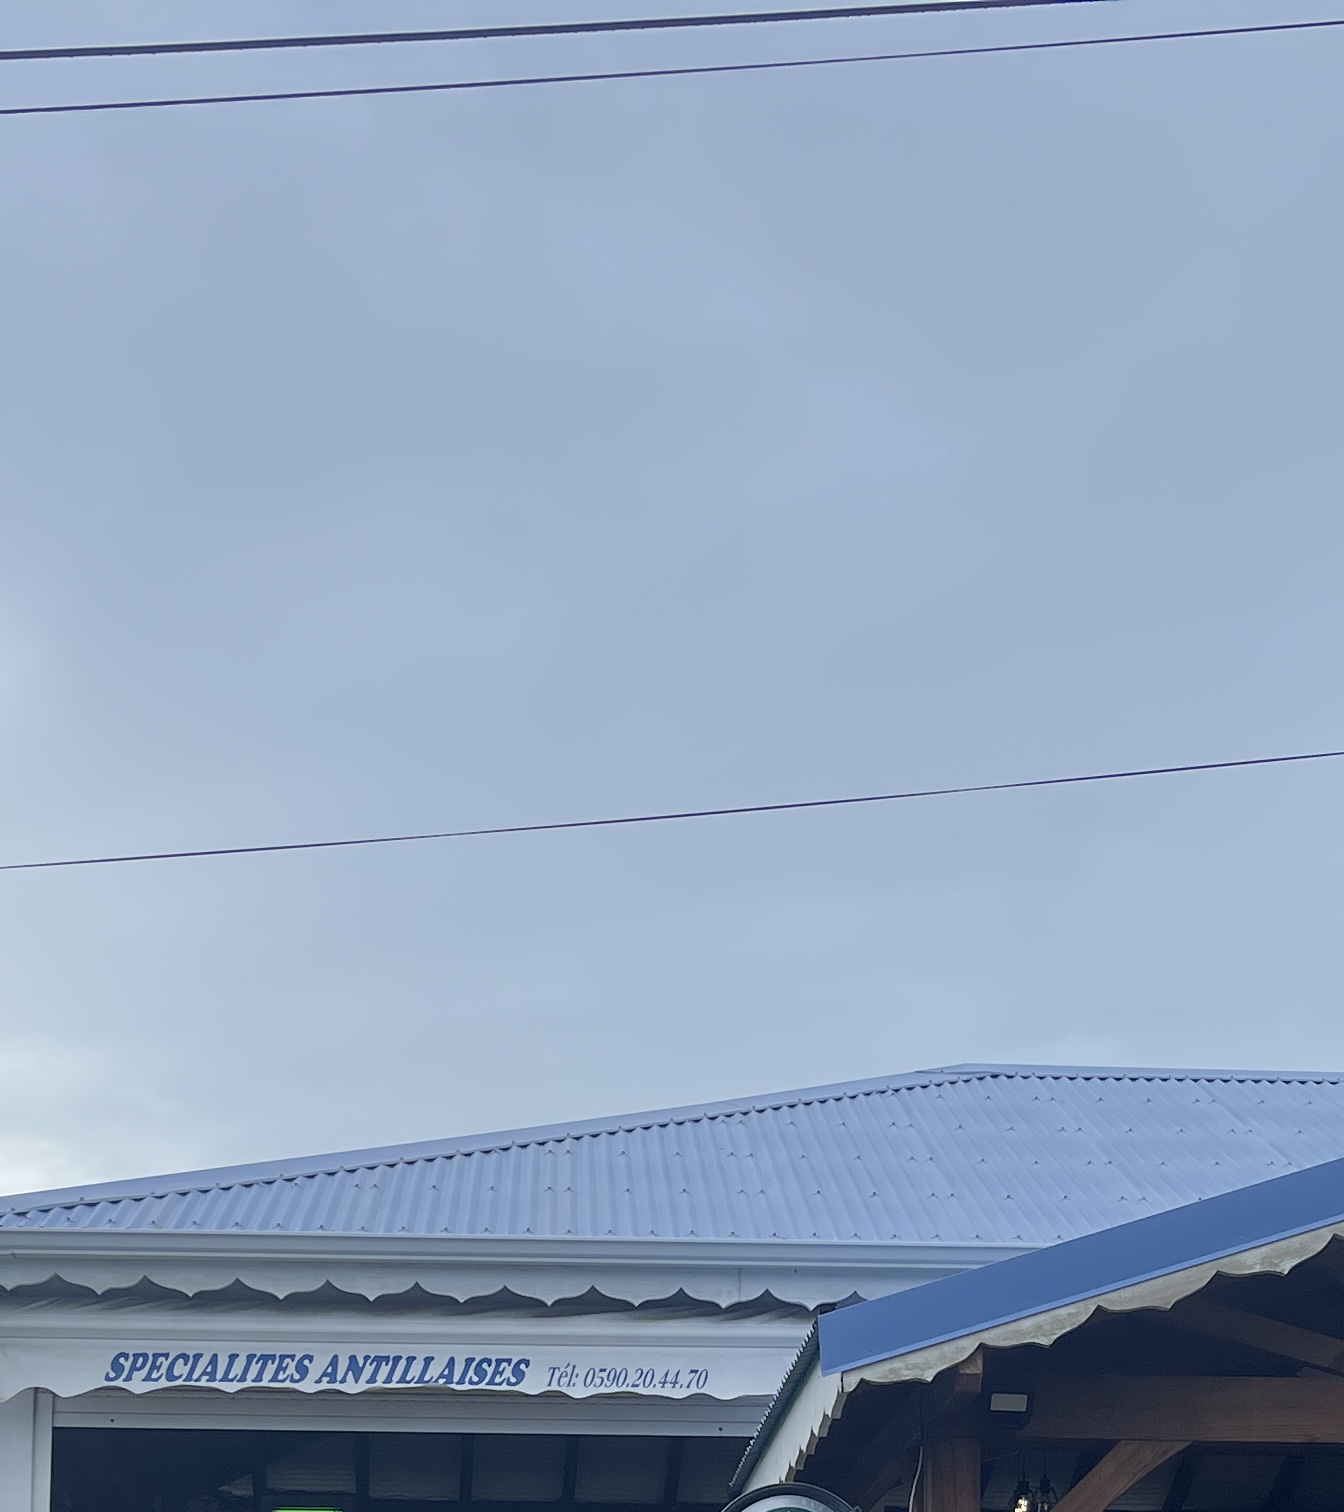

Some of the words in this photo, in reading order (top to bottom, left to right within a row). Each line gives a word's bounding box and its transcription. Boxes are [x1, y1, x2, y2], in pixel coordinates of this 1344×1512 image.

[105, 1352, 314, 1384] SPECIALITES
[315, 1353, 531, 1387] ANTILLAISES
[546, 1362, 579, 1388] Tél:
[583, 1367, 709, 1390] 0590.20.44.70
